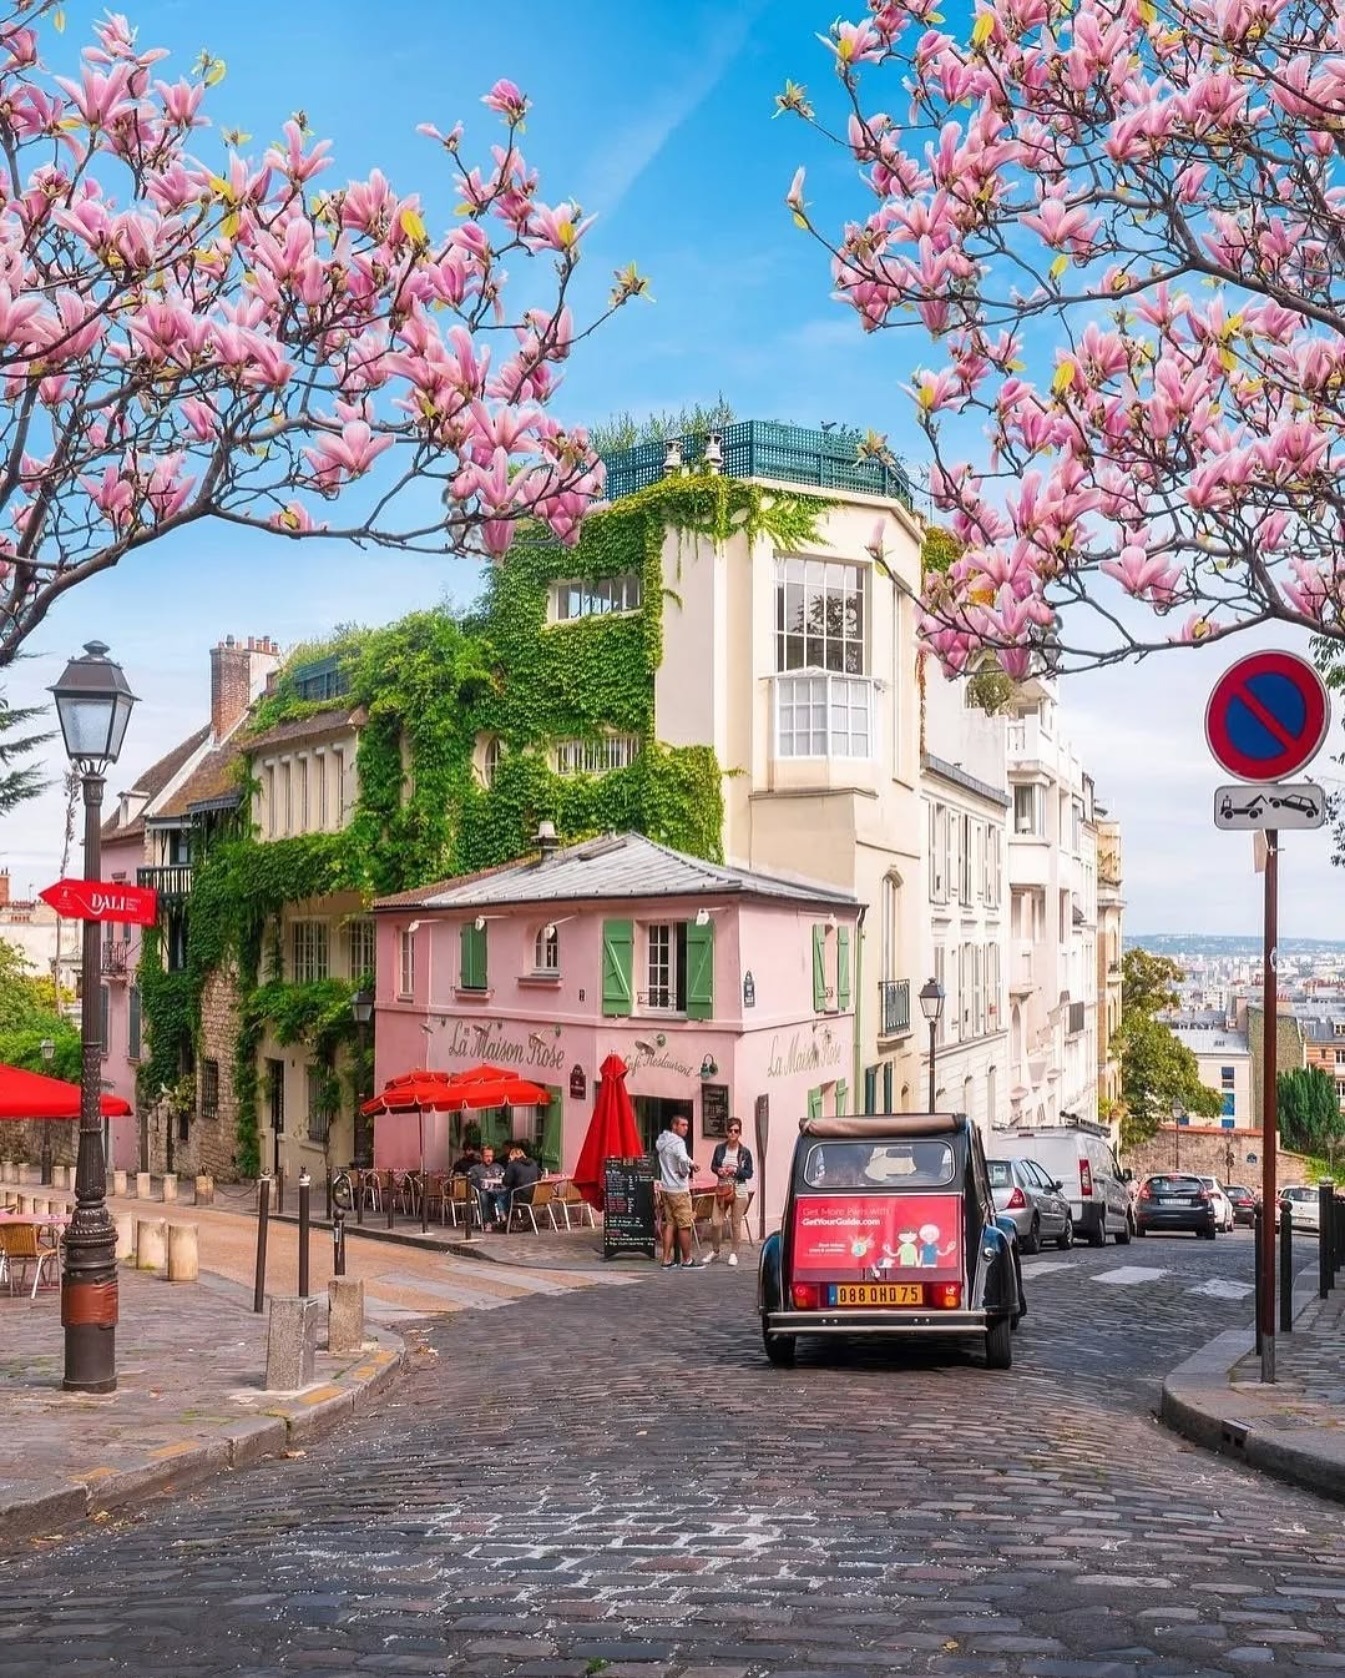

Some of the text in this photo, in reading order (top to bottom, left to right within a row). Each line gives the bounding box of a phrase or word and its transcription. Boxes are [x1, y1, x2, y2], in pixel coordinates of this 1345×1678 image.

[449, 1020, 565, 1069] La Maison Rose
[767, 1034, 782, 1078] La
[643, 1052, 694, 1078] Restaurant
[802, 1217, 881, 1227] GetYourGuide.com
[901, 1286, 919, 1302] 75
